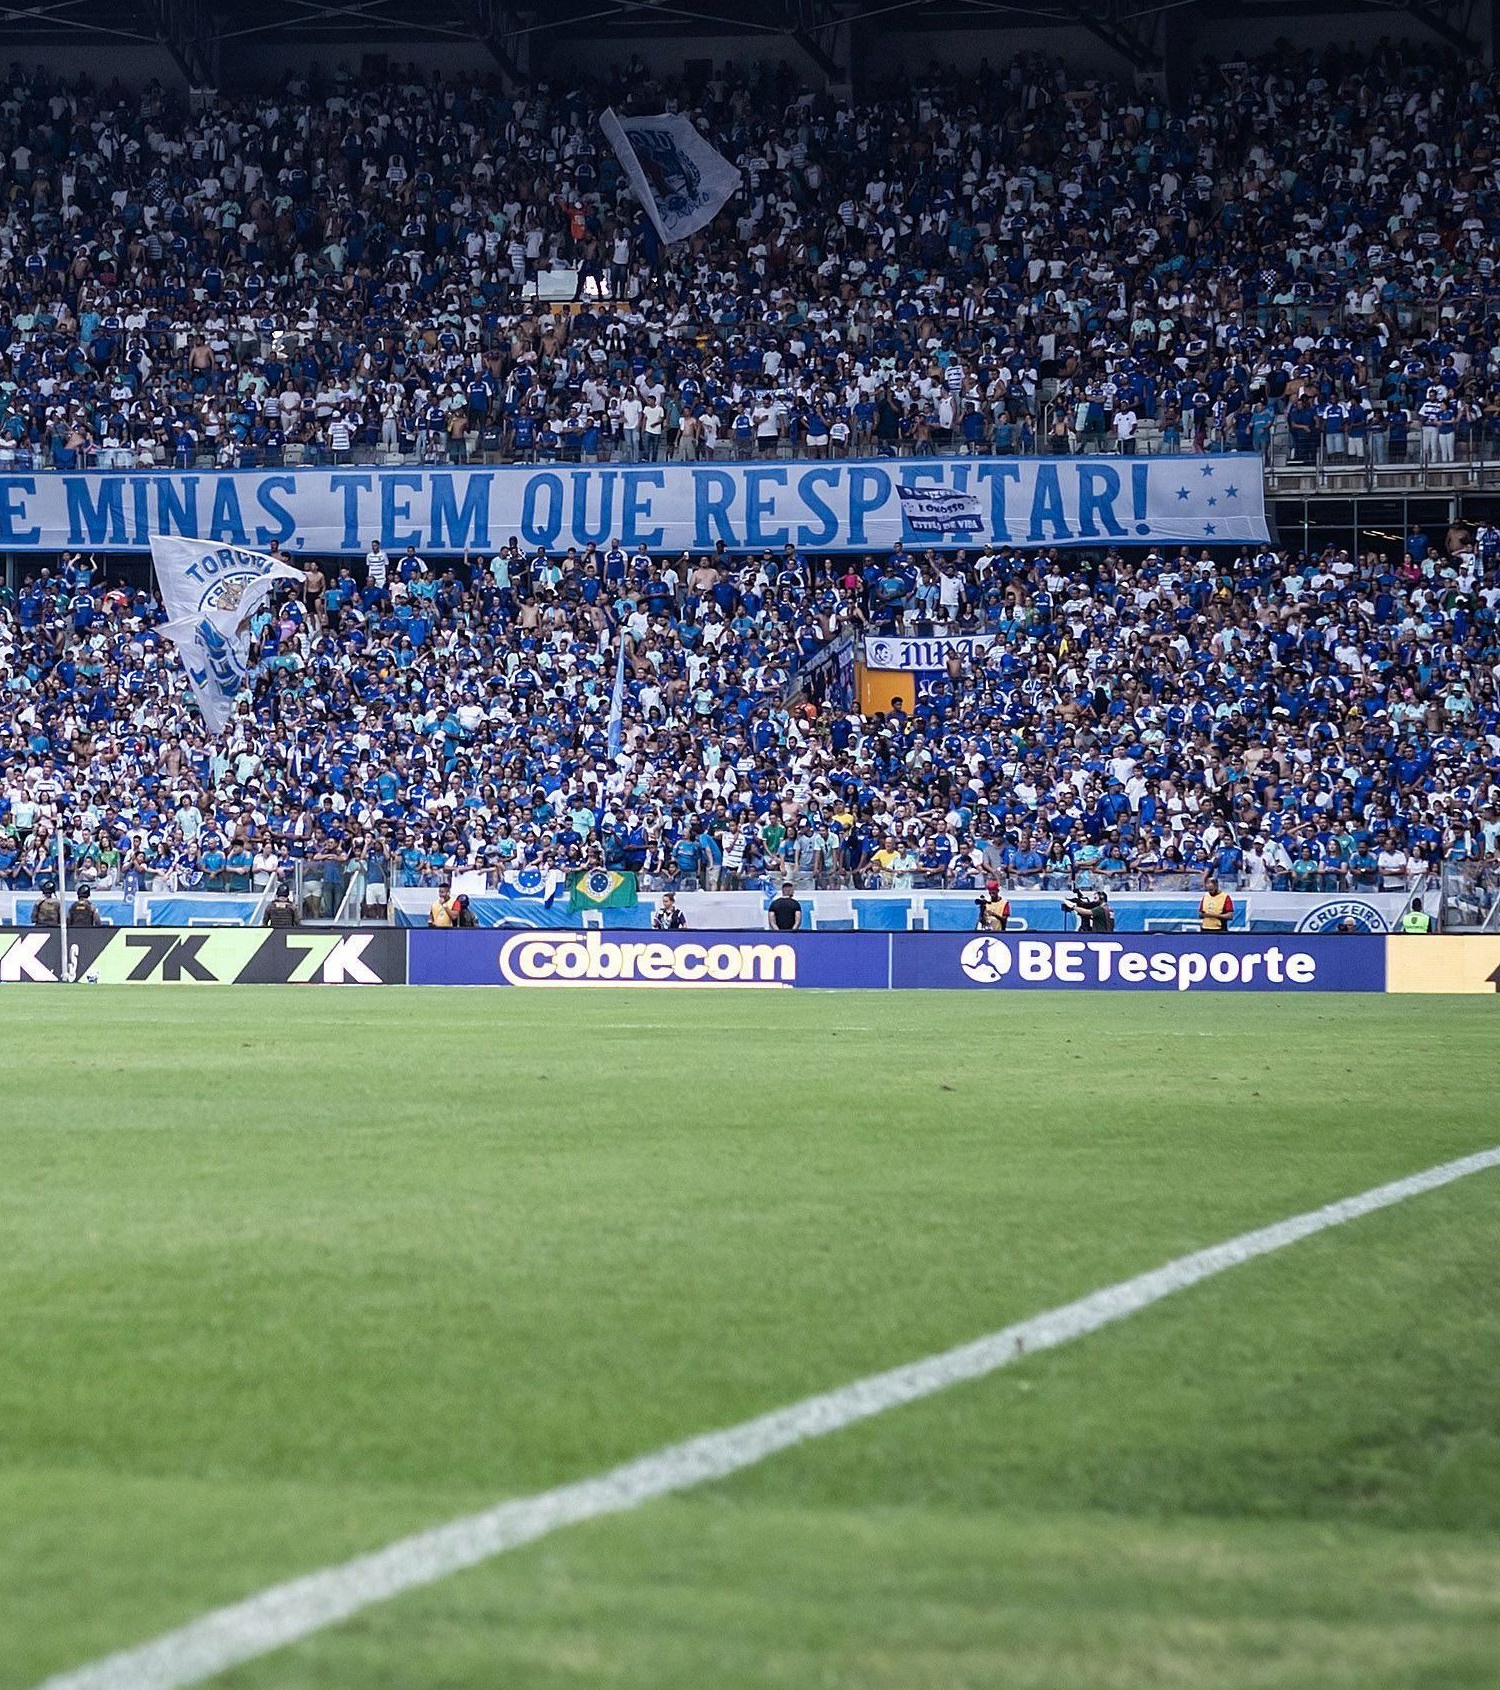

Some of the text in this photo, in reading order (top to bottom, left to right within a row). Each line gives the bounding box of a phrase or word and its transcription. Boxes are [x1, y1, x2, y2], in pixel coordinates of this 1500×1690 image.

[62, 474, 304, 550] MINAS,
[329, 473, 495, 548] TEM
[521, 470, 666, 549] QUE
[1309, 905, 1381, 931] CRUZEIRO
[126, 935, 220, 981] 7K
[286, 935, 383, 983] 7K
[519, 931, 796, 980] cobrecom
[1018, 941, 1316, 991] BETesporte
